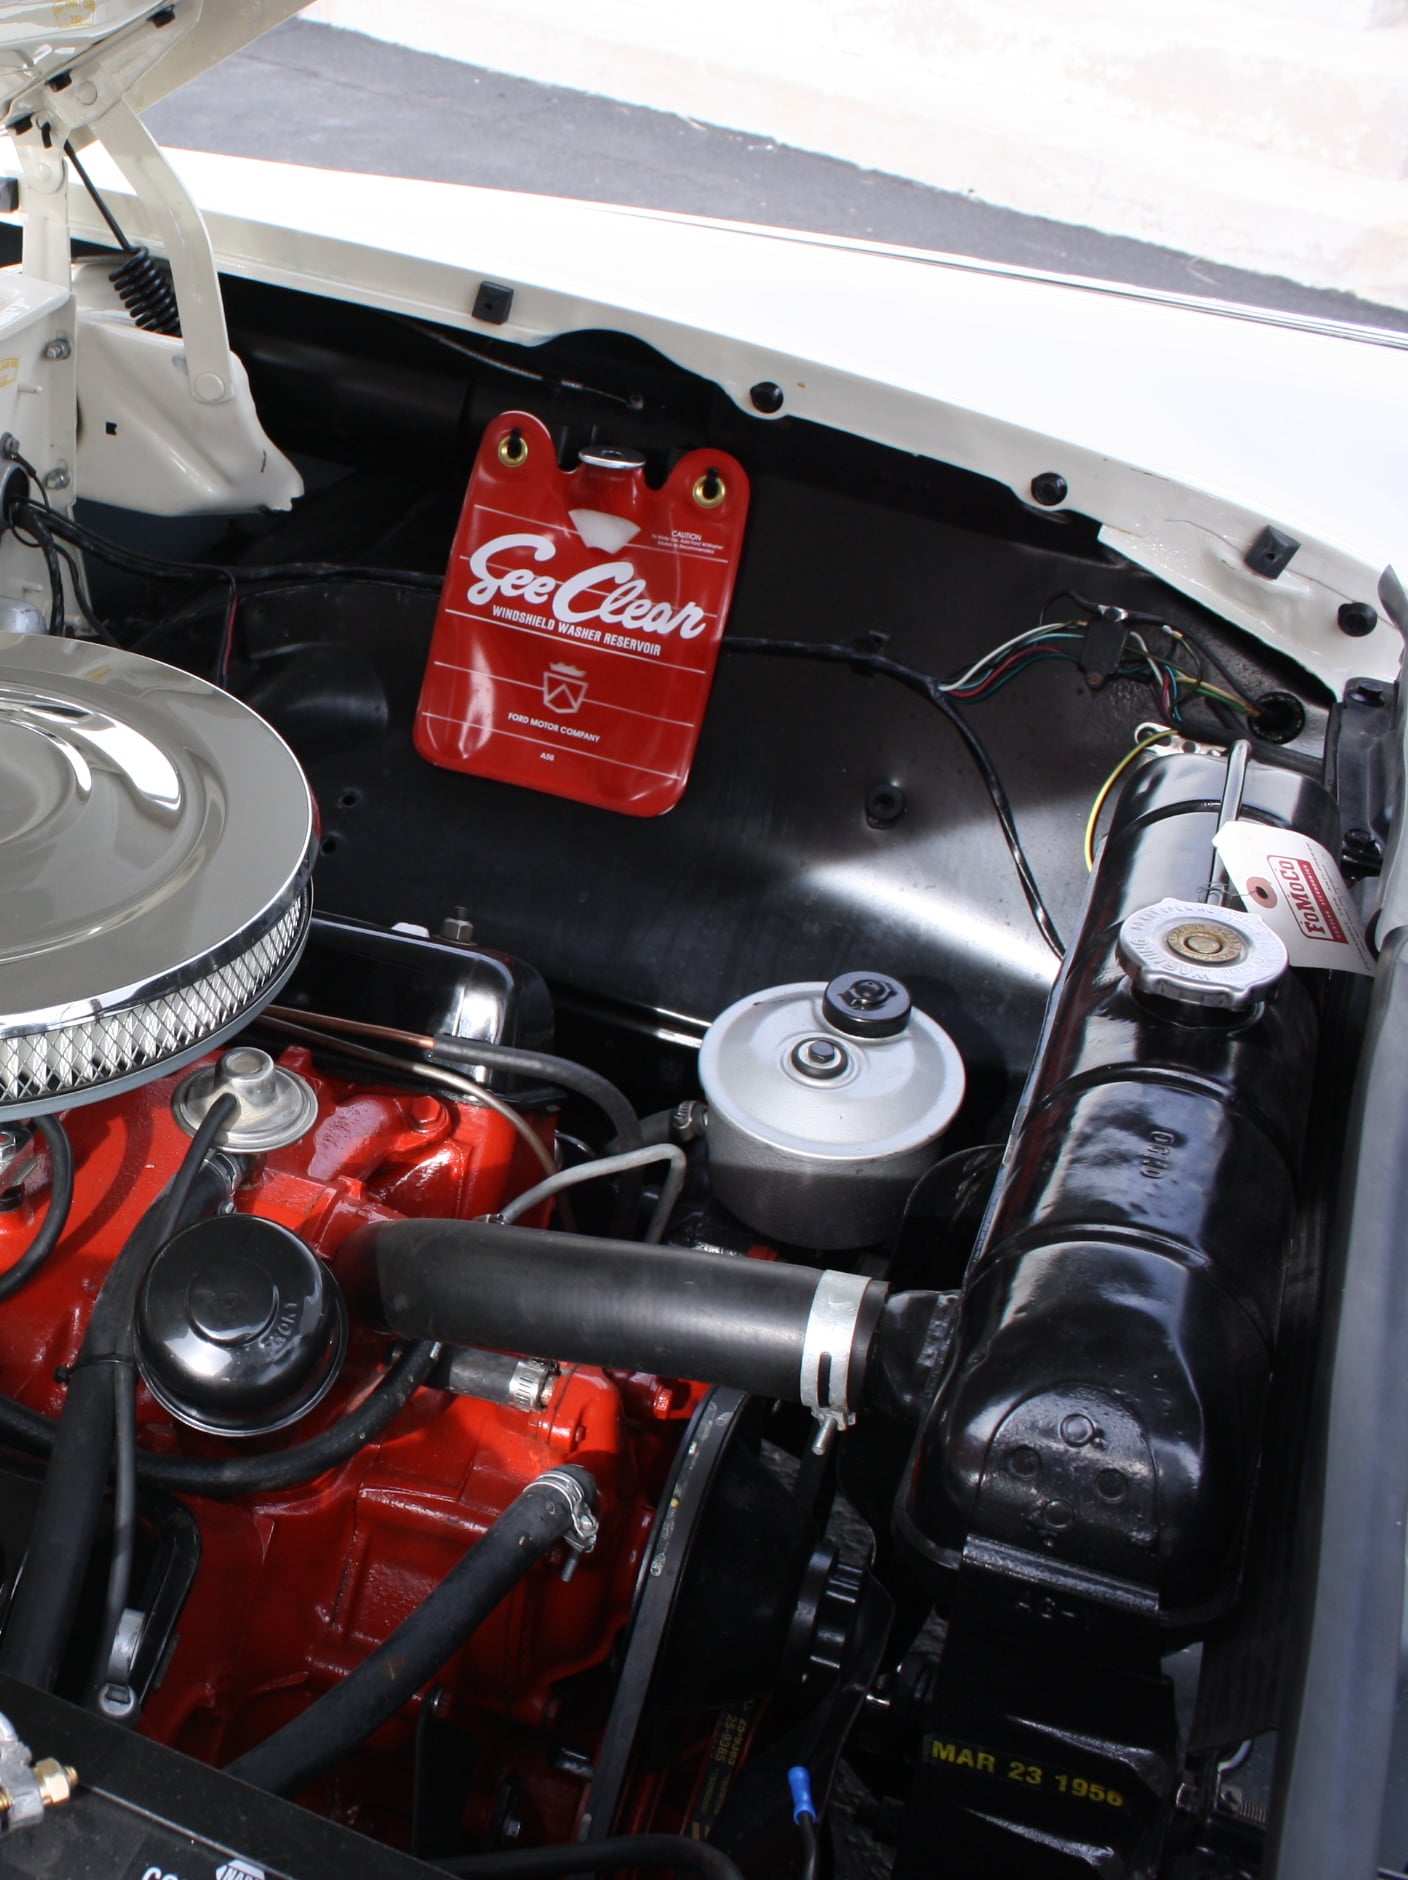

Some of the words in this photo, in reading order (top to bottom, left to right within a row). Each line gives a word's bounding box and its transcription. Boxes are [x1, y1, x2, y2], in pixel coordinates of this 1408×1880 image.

[467, 533, 556, 606] See
[552, 562, 707, 640] Clear
[493, 605, 555, 631] WINDSHIELD
[558, 621, 602, 643] WASHER
[604, 631, 661, 657] RESERVOIR
[508, 712, 529, 724] FORD
[530, 716, 559, 733] MOTOR
[560, 723, 601, 743] COMPANY
[1277, 860, 1325, 933] FoMoCo
[931, 1739, 996, 1774] MAR
[1008, 1761, 1042, 1785] 23
